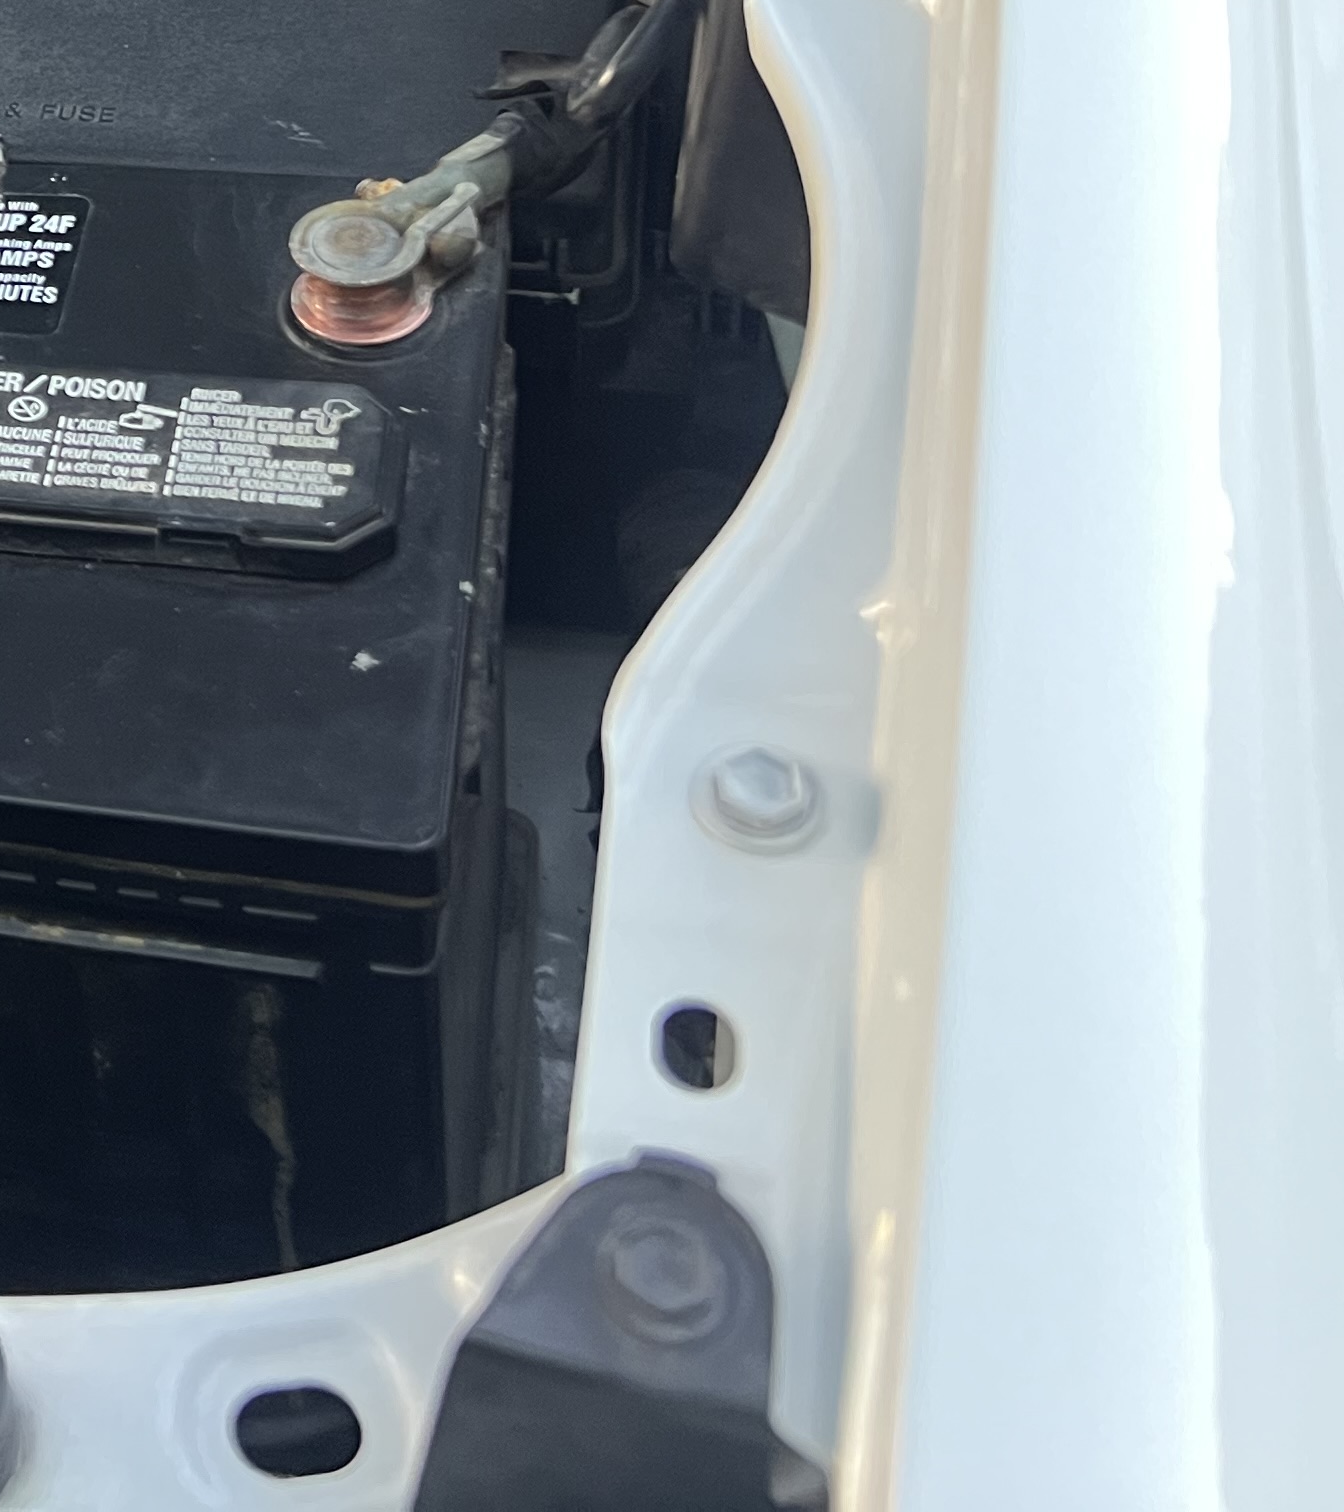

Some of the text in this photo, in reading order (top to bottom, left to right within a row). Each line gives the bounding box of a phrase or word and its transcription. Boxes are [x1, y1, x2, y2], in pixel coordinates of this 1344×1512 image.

[5, 101, 22, 118] &
[40, 104, 117, 123] FUSE
[8, 201, 40, 212] With
[28, 215, 76, 234] 24F
[33, 240, 73, 252] Amps
